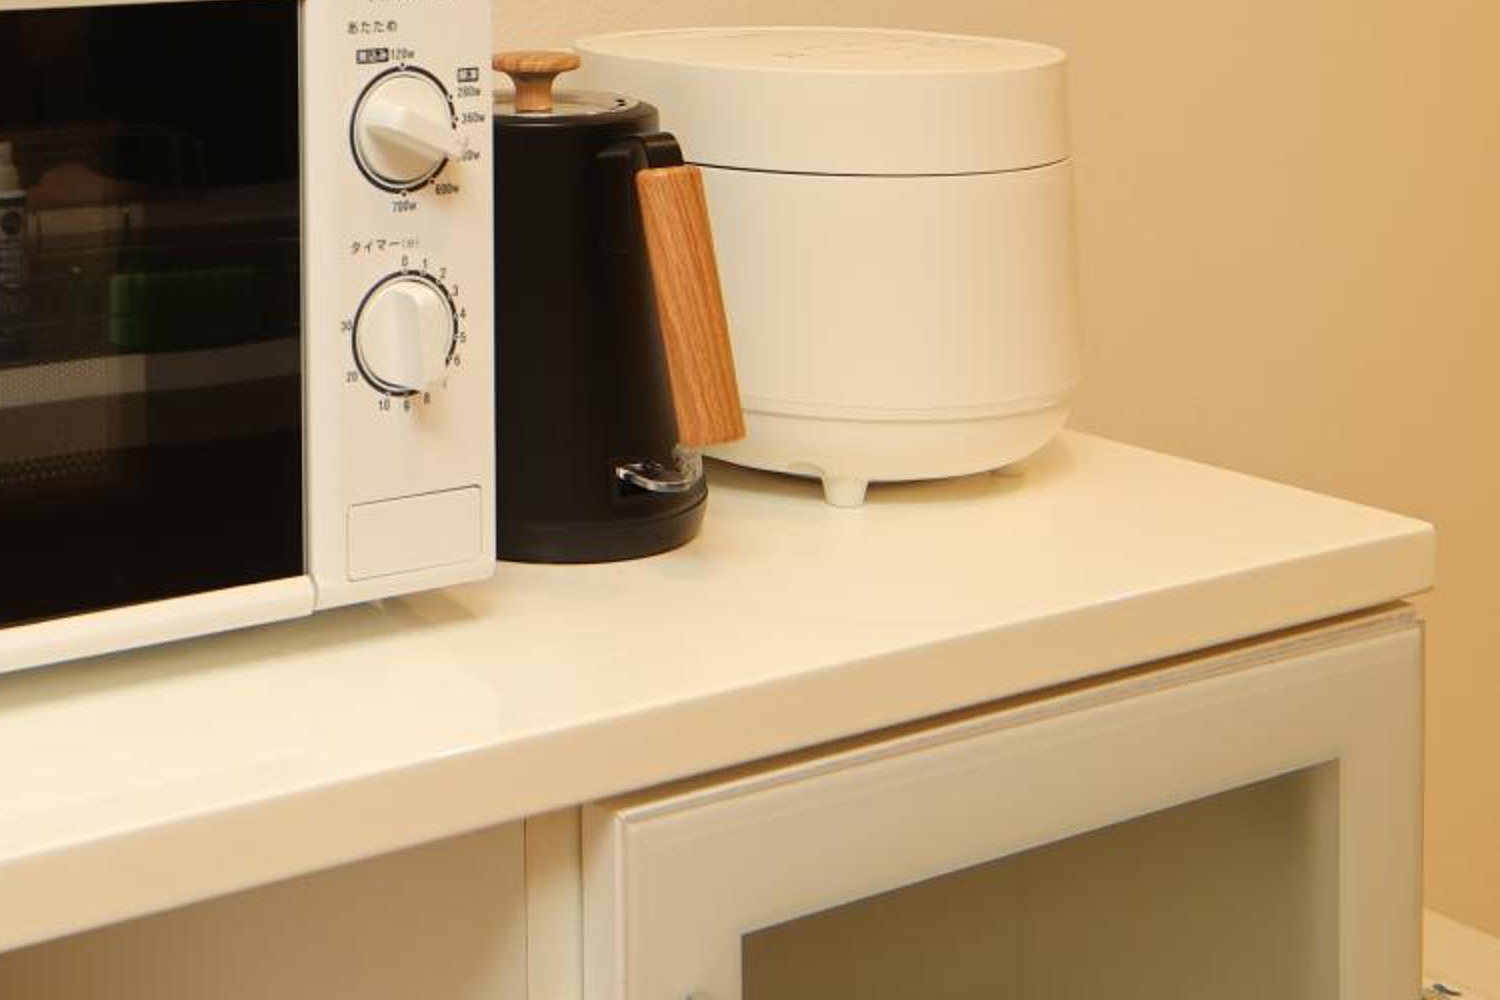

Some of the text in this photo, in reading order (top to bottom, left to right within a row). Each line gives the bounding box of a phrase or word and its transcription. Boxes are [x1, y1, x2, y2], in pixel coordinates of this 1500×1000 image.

[347, 20, 398, 34] あたため
[379, 399, 391, 411] 10
